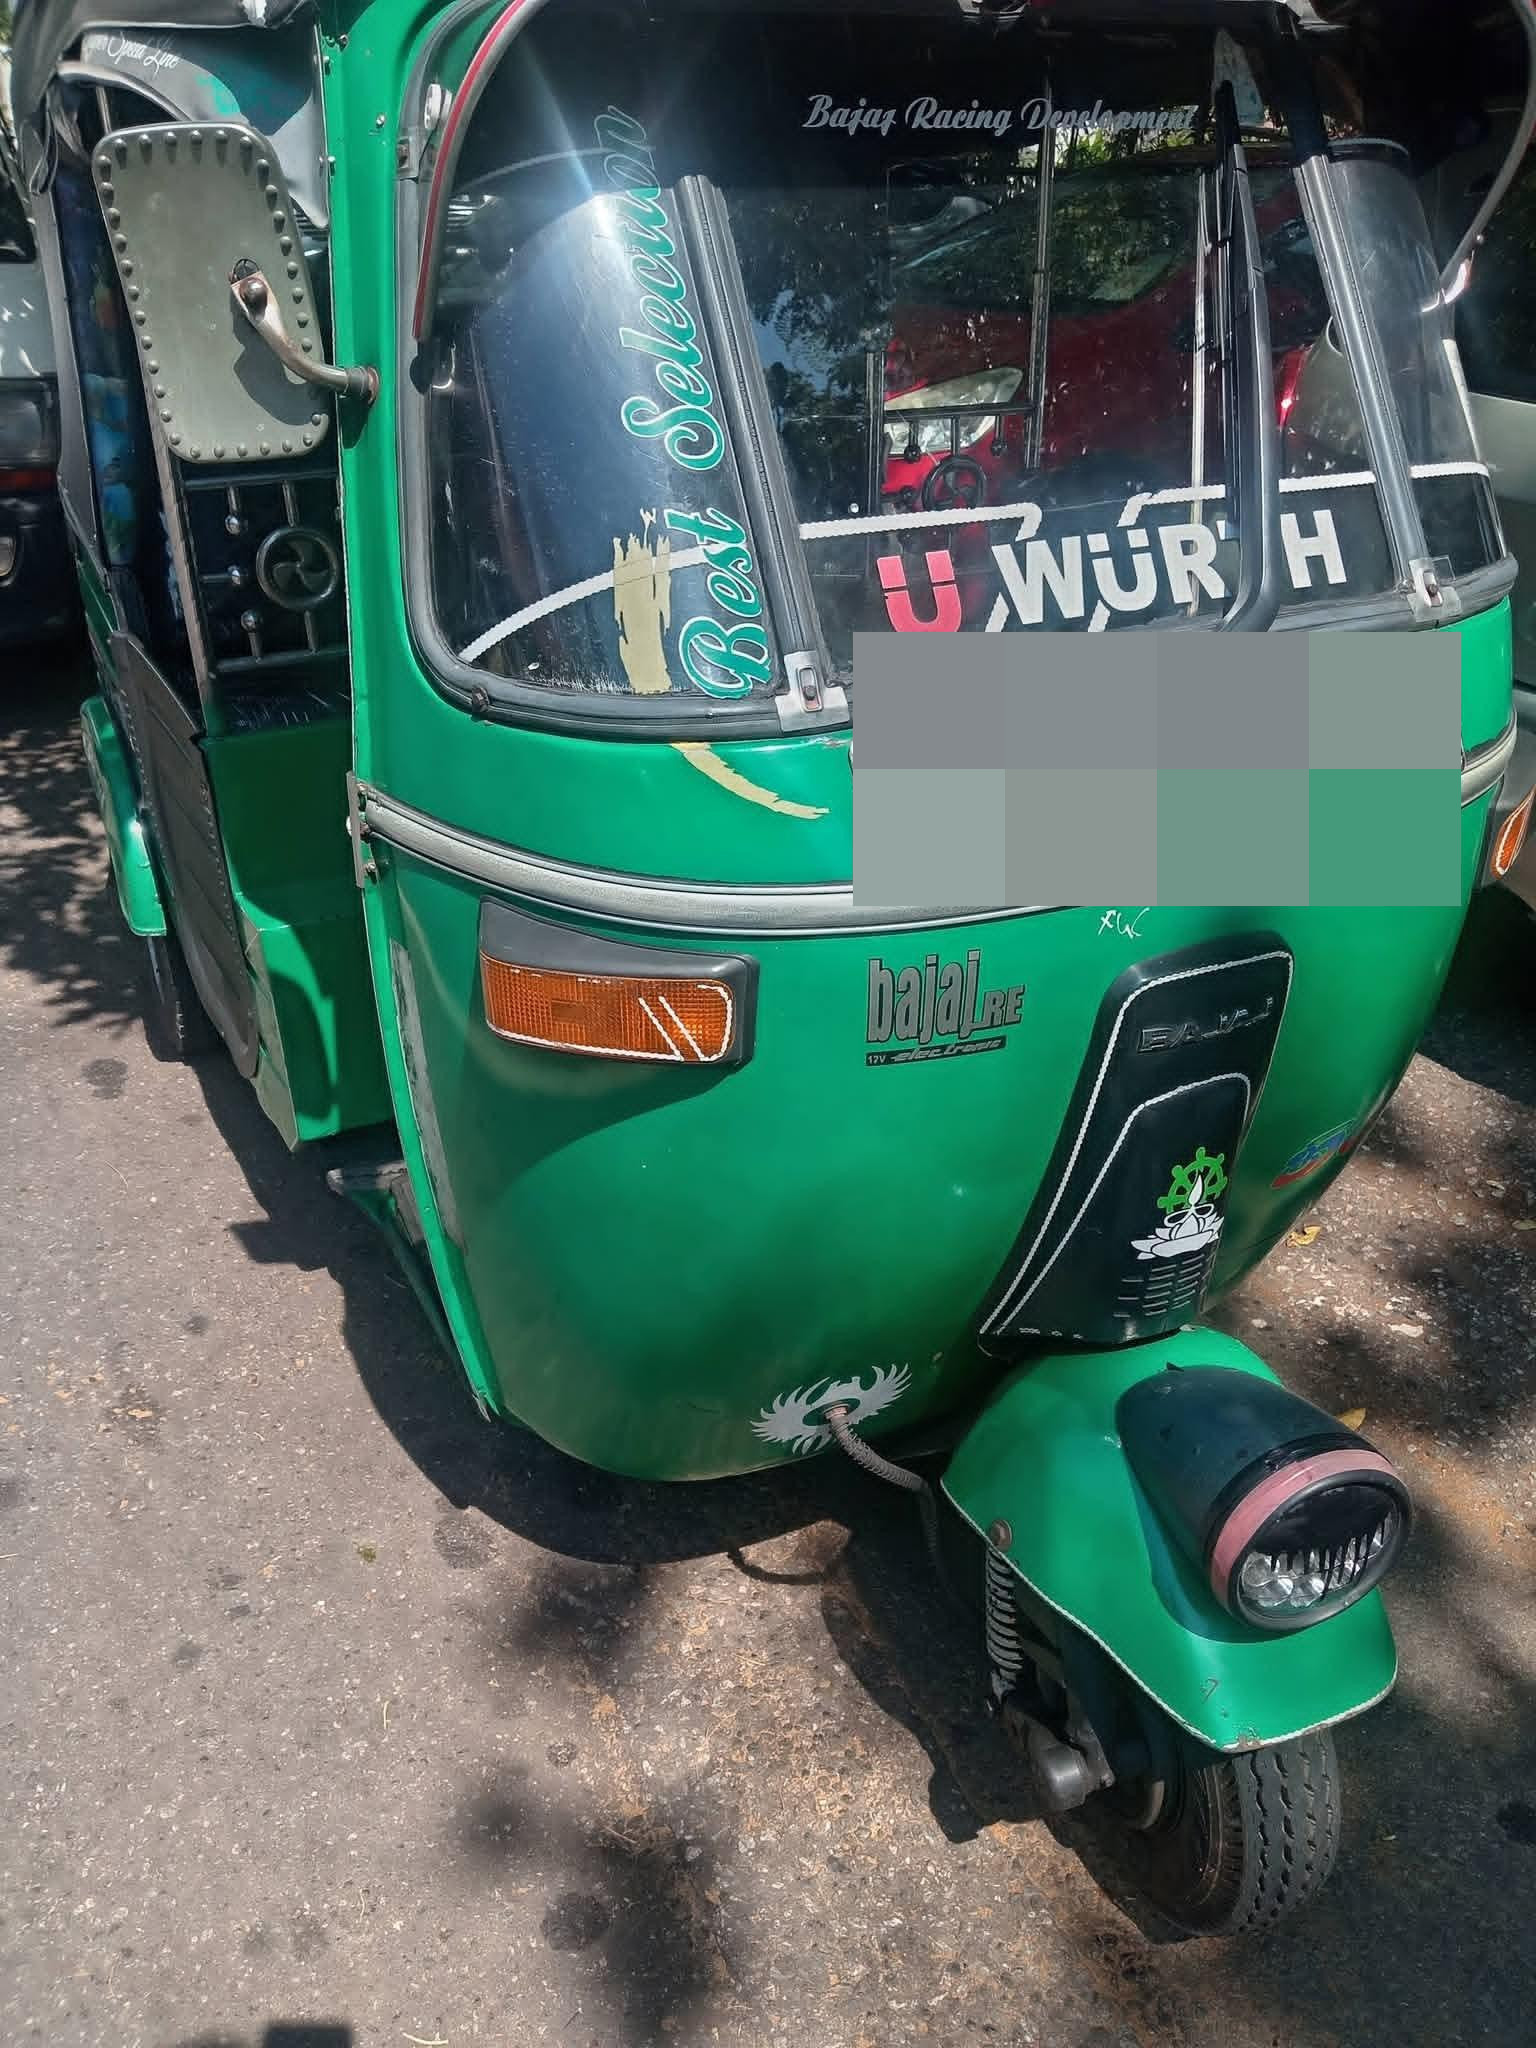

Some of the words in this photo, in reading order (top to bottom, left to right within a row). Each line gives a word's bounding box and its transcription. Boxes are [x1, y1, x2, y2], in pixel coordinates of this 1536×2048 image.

[801, 94, 897, 136] Bajaj
[905, 96, 1012, 137] Racing
[1020, 97, 1200, 136] Development
[594, 105, 725, 471] Selection
[664, 506, 771, 700] Best
[991, 508, 1347, 625] WÜRH
[867, 949, 982, 1044] bajaj
[890, 1039, 1003, 1063] electronic
